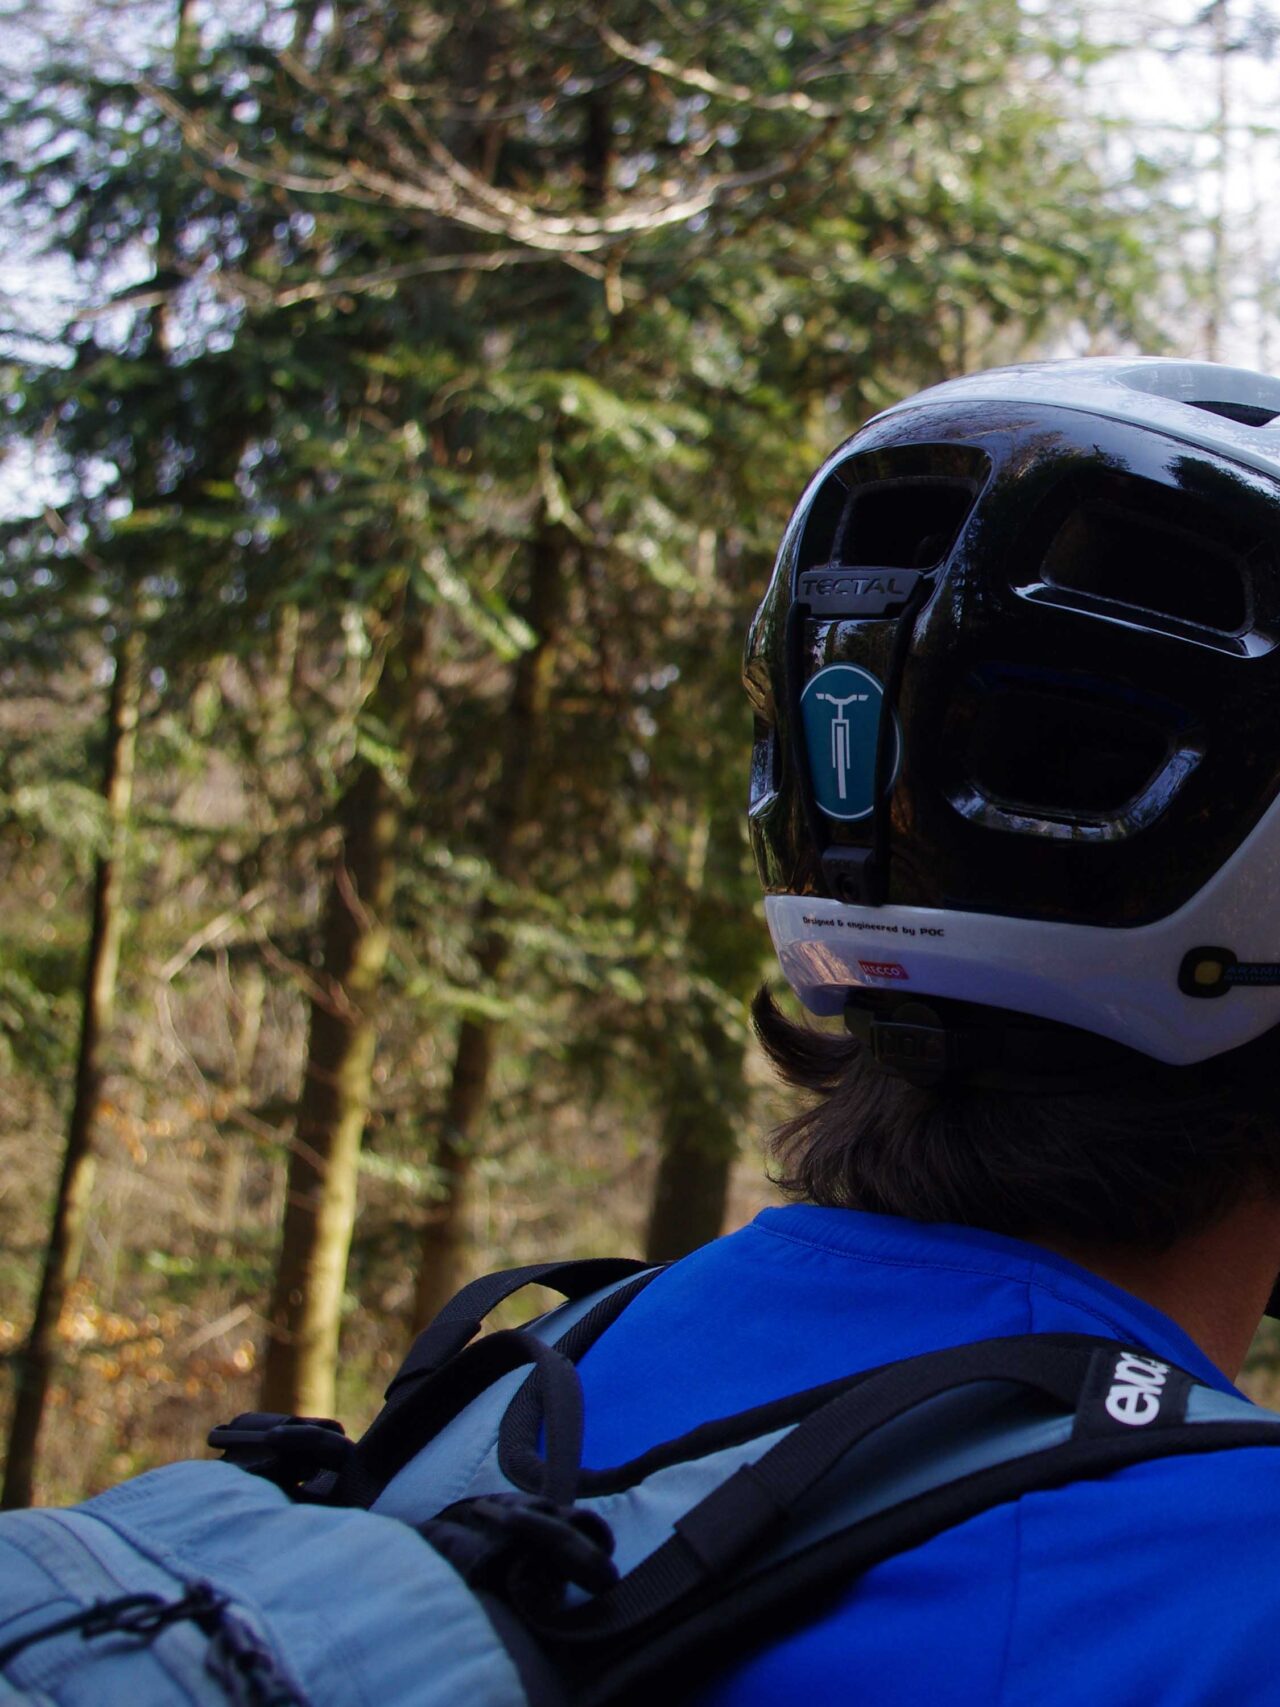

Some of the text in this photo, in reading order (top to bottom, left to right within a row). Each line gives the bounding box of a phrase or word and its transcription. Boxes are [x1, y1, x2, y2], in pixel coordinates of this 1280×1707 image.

[802, 578, 904, 596] TECTAL
[847, 921, 899, 933] engineered
[902, 926, 916, 936] by
[920, 927, 946, 937] POC
[862, 965, 901, 976] RECCO
